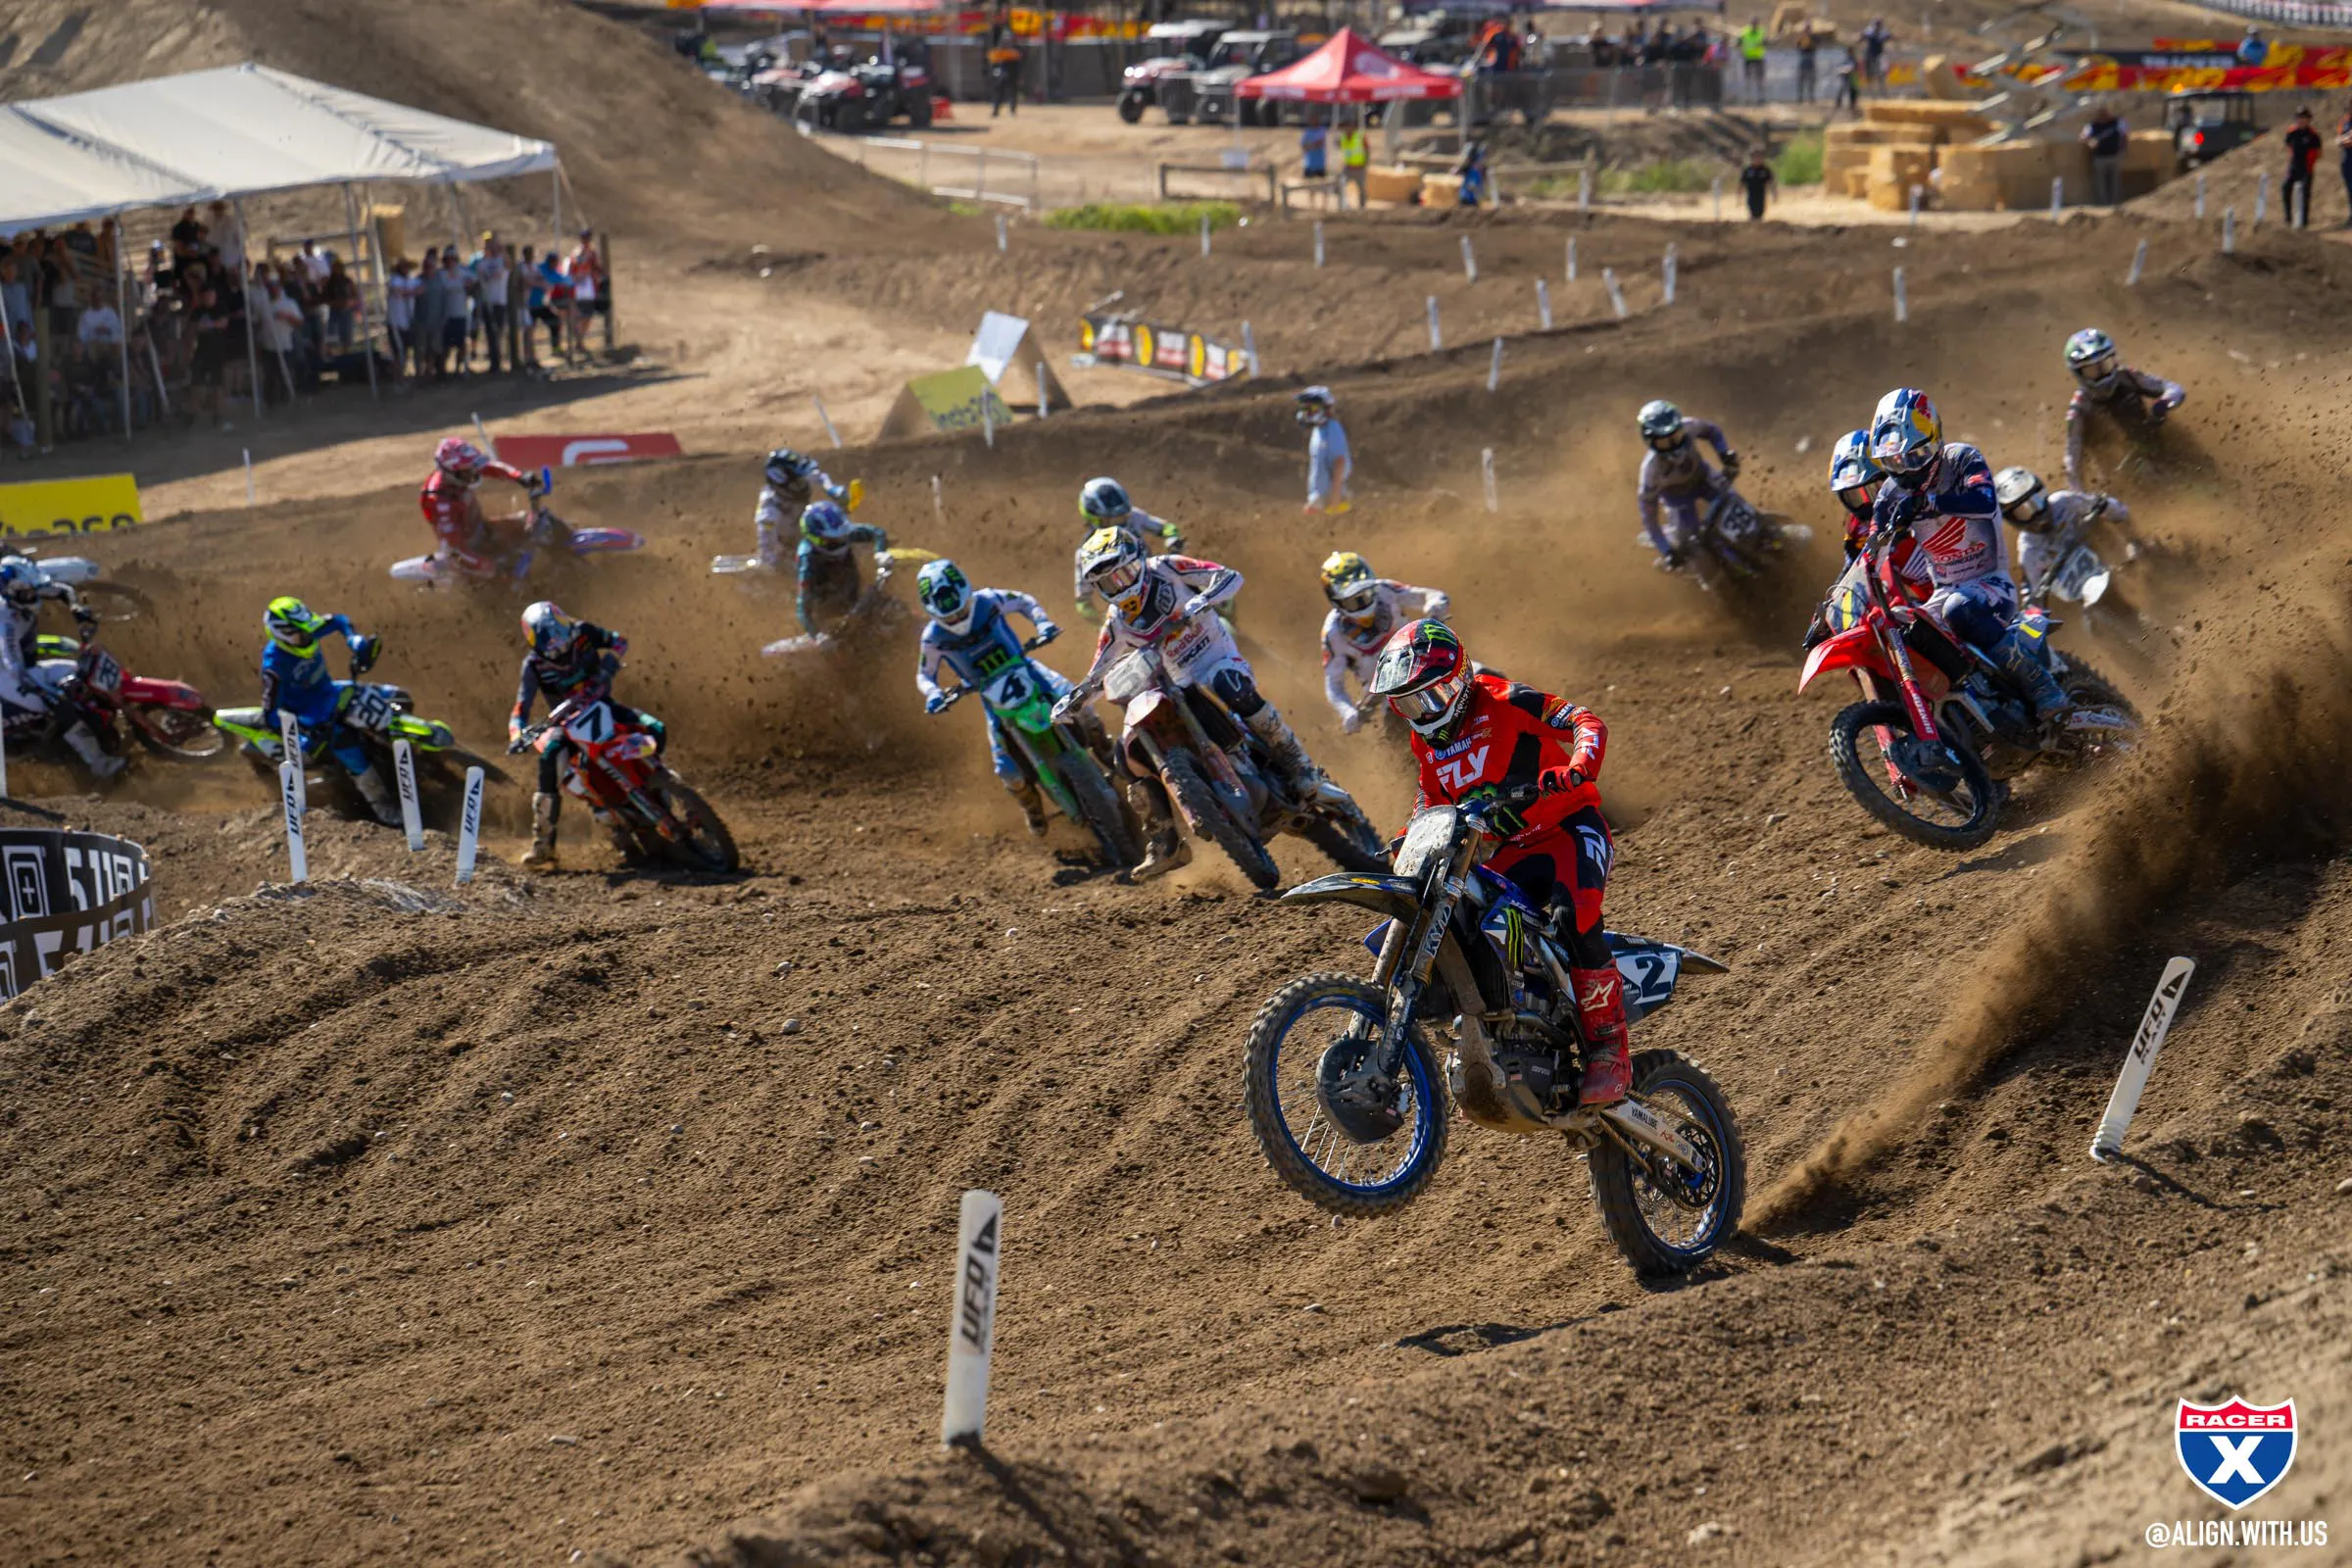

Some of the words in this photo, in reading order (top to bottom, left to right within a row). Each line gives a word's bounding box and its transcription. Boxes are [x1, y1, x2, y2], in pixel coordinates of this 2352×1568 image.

[1001, 673, 1027, 704] 4
[358, 693, 388, 728] 20
[575, 705, 603, 742] 7
[1912, 693, 1935, 734] DUNLOP
[1446, 736, 1472, 757] YAMAH
[1436, 744, 1491, 792] FLY
[285, 792, 300, 836] UFO
[1634, 956, 1672, 999] 2
[2133, 997, 2163, 1059] UFO
[1631, 1105, 1659, 1130] YAMALUBE
[960, 1253, 985, 1347] UFO
